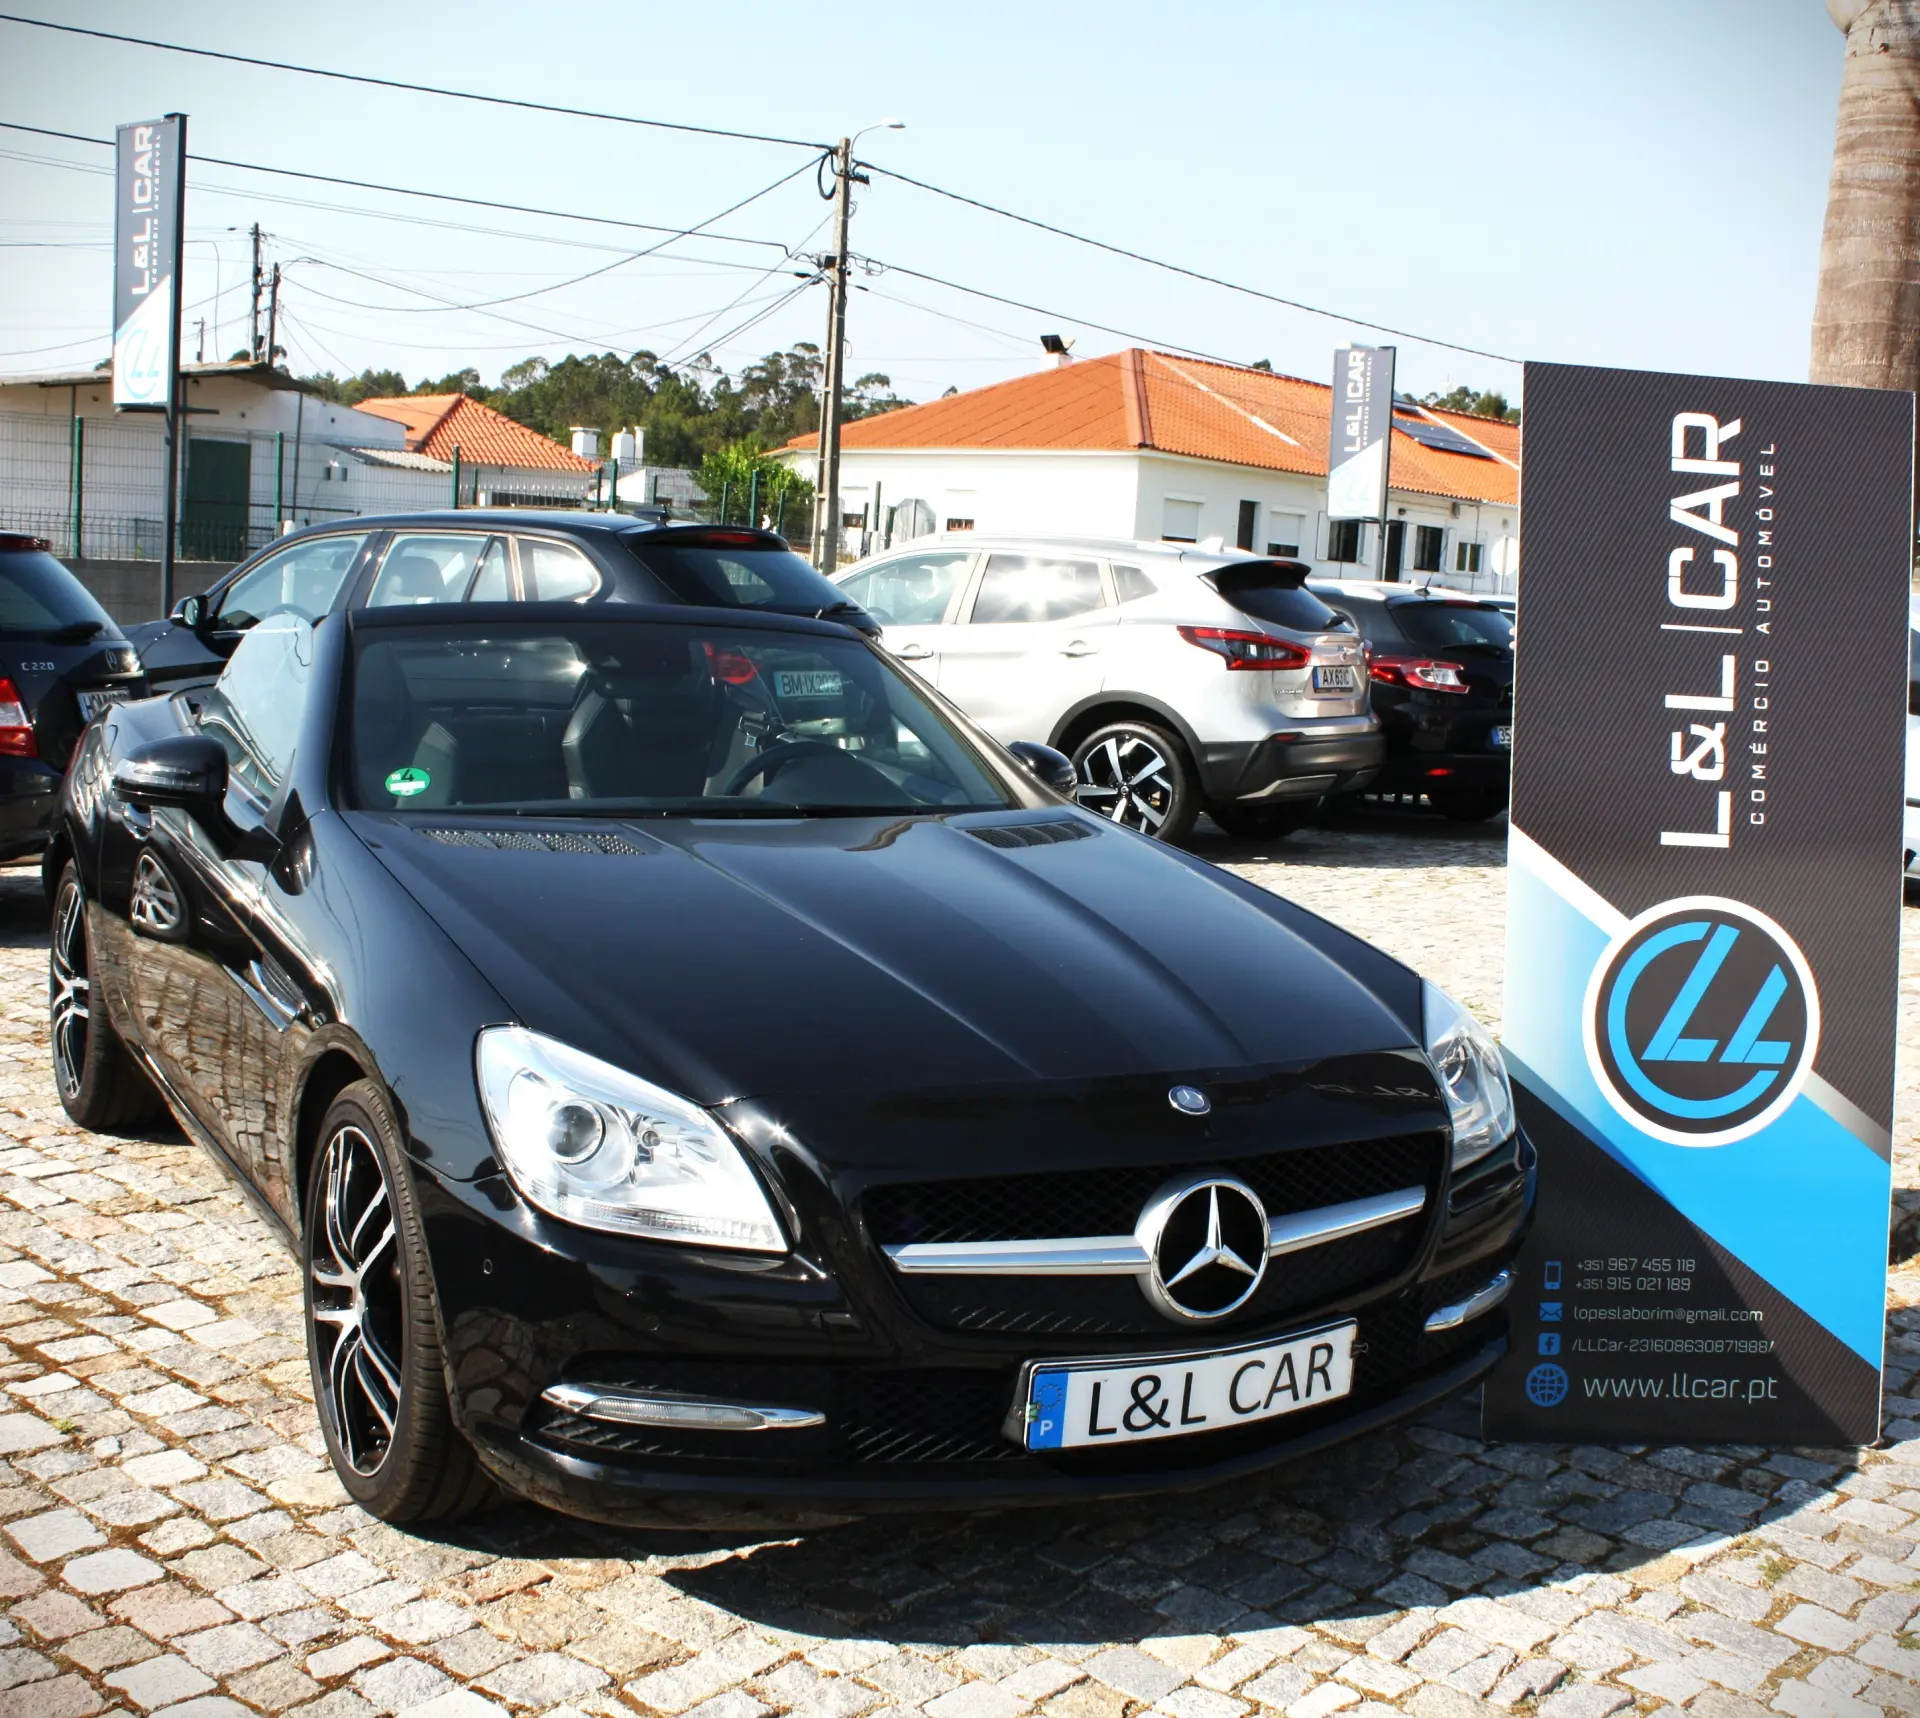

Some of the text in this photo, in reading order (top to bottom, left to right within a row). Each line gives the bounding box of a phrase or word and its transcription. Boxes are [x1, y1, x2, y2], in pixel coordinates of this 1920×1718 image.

[132, 126, 153, 295] L&L CAR
[1344, 351, 1366, 452] L&L CAR
[1660, 411, 1742, 849] L&L CAR
[1750, 443, 1776, 826] COMÉRCIO AUTOMÓVEL
[21, 661, 55, 671] C 220
[401, 769, 415, 781] 4
[1576, 1257, 1696, 1272] +351 967 455 118
[1575, 1276, 1691, 1291] +351 915 021 189
[1573, 1306, 1764, 1324] lopeslaborim@gmail.com
[1088, 1342, 1334, 1438] L&L CAR
[1583, 1372, 1779, 1405] www.llcar.pt
[1039, 1419, 1054, 1437] P
